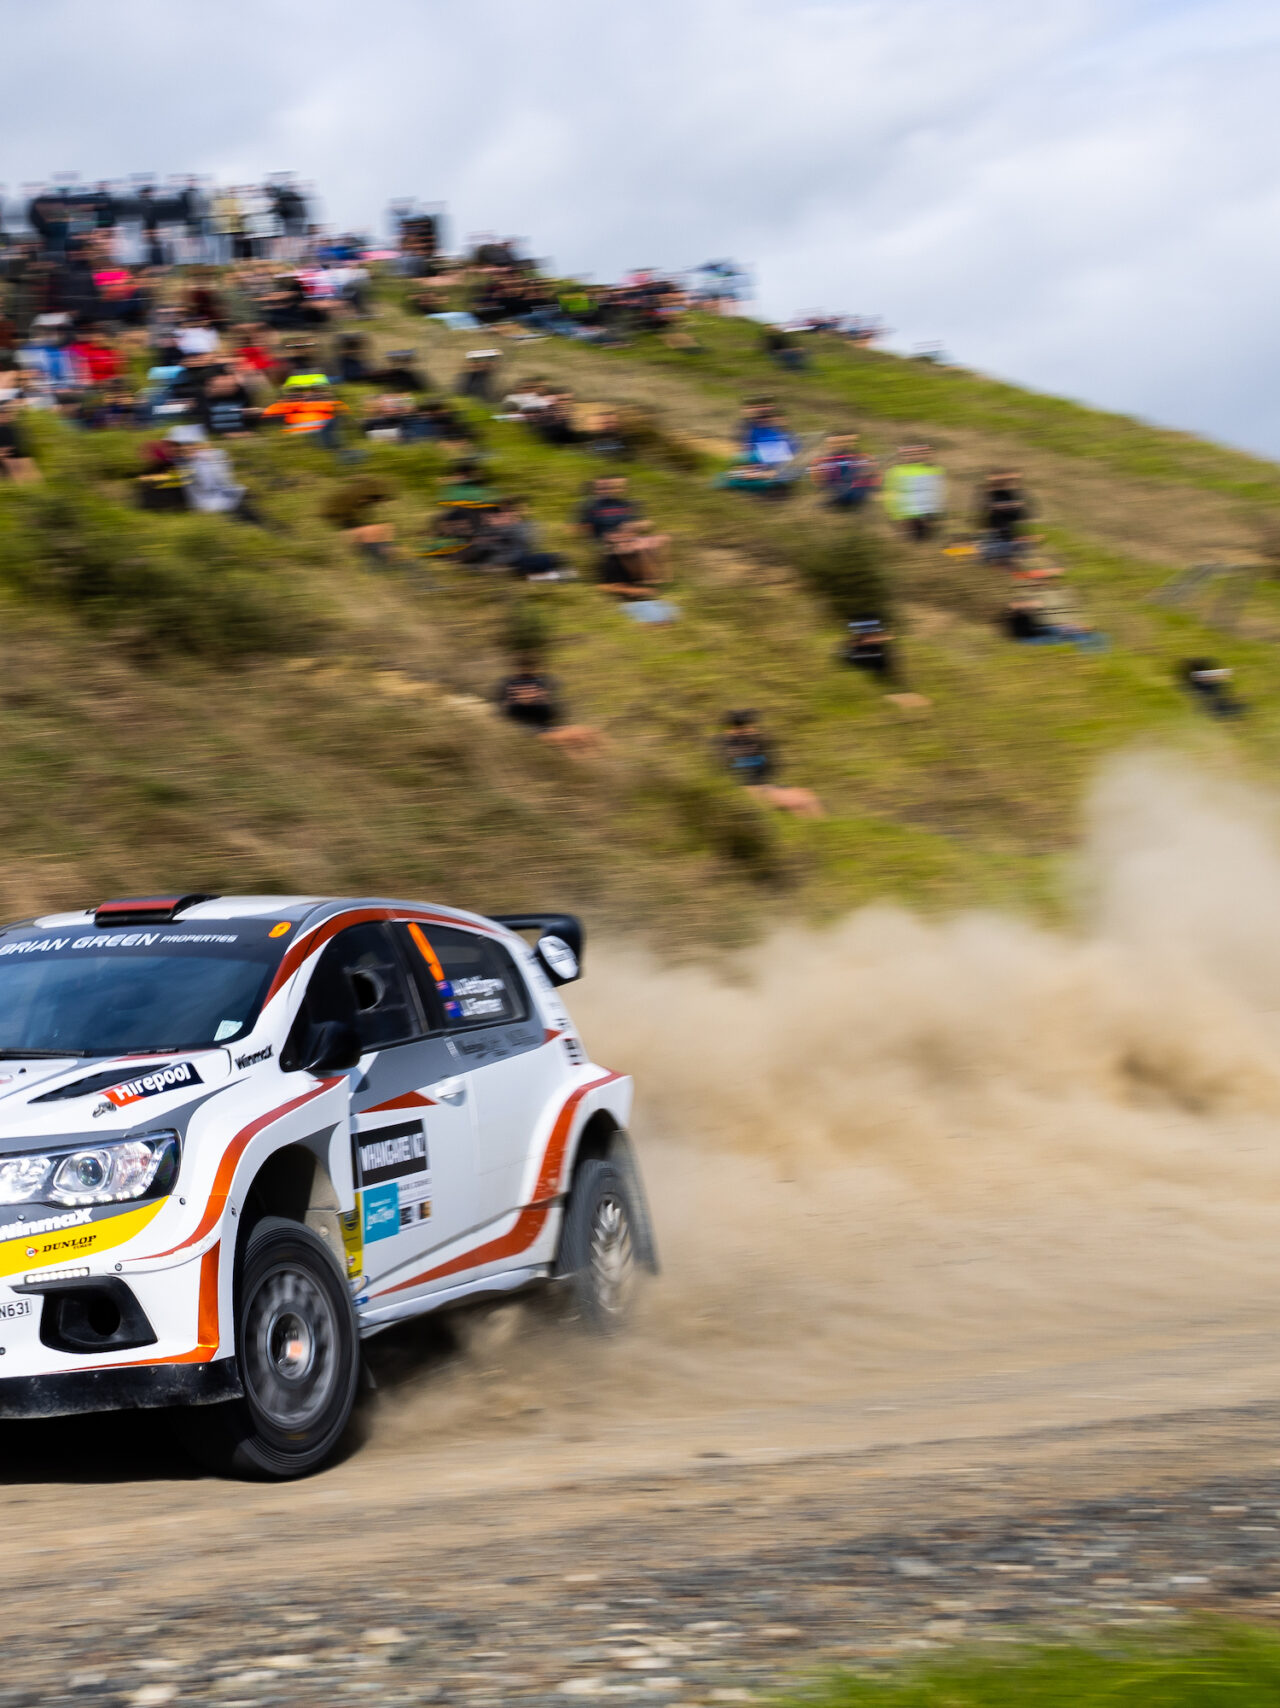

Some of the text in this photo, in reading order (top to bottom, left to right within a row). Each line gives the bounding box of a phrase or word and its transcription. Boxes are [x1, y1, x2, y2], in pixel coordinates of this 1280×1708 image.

[71, 933, 160, 949] GREEN
[159, 934, 239, 943] PROPERTIES
[114, 1063, 192, 1100] Hirepool
[42, 1234, 97, 1253] DUNLOP
